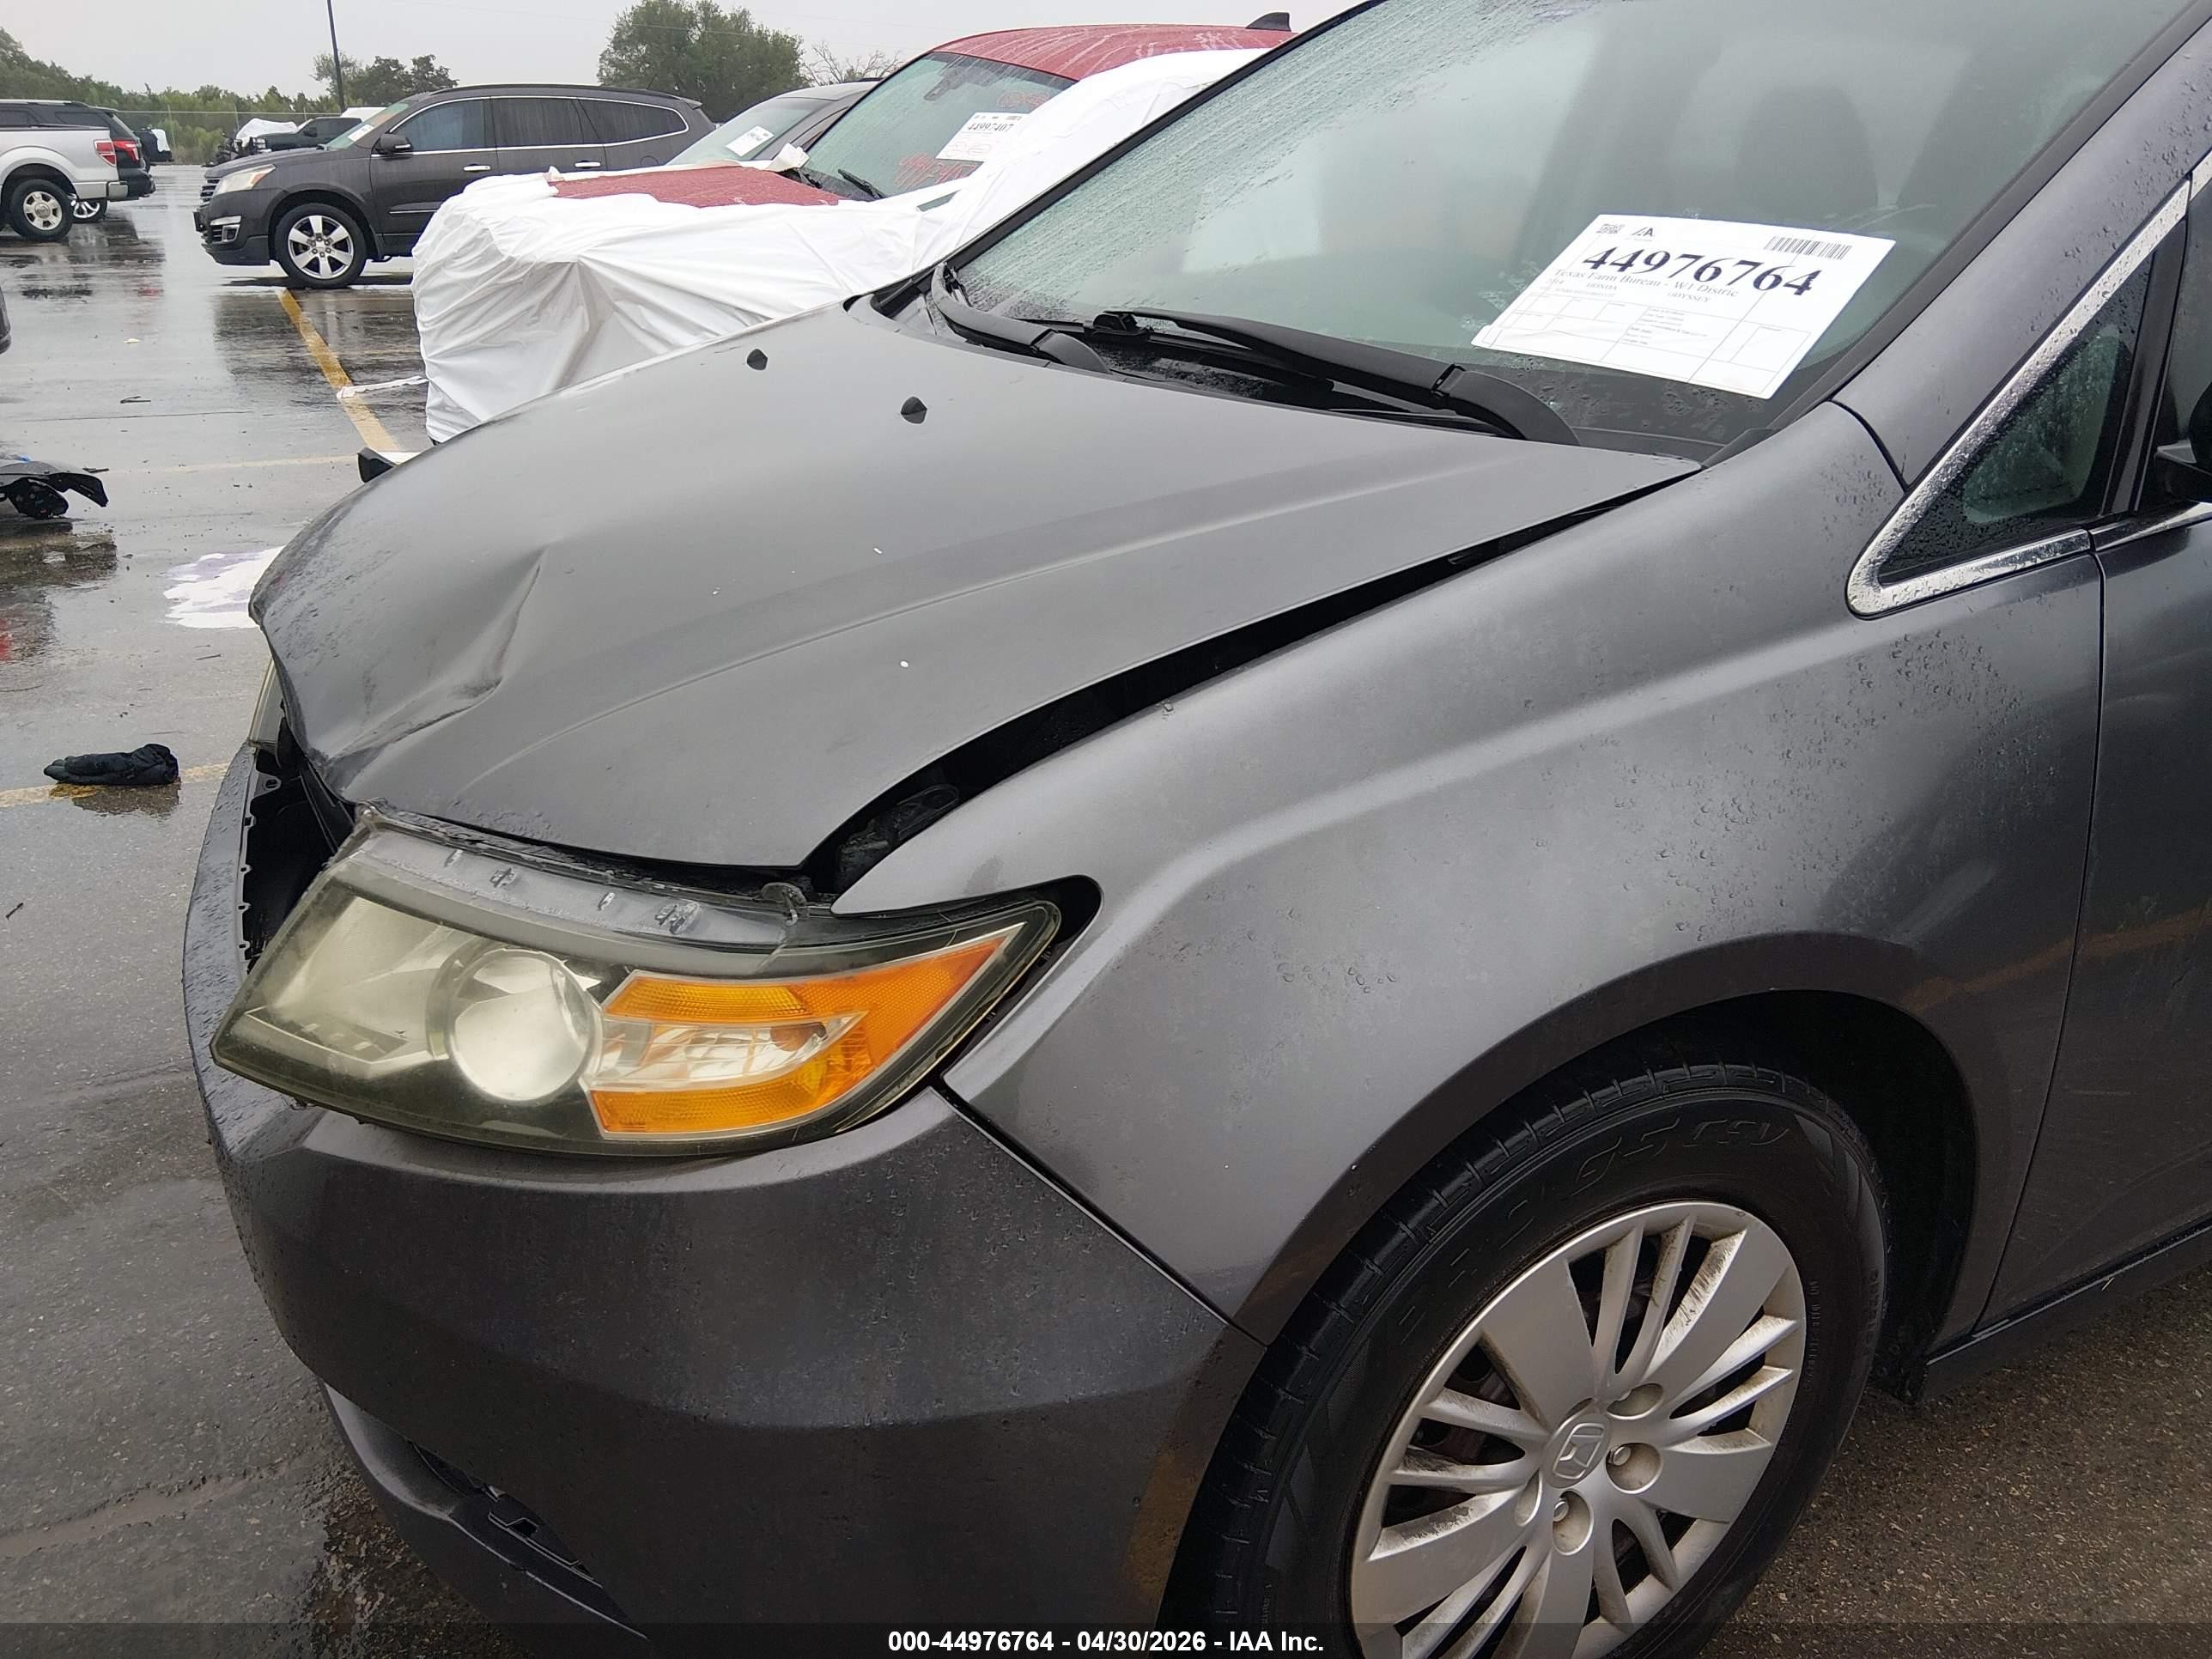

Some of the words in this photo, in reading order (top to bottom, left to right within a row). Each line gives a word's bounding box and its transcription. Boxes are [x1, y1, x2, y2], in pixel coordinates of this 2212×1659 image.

[1554, 269, 1585, 279] Texas
[1587, 272, 1618, 283] Farm
[1620, 275, 1662, 288] Bureau
[1582, 246, 1822, 296] 44976764
